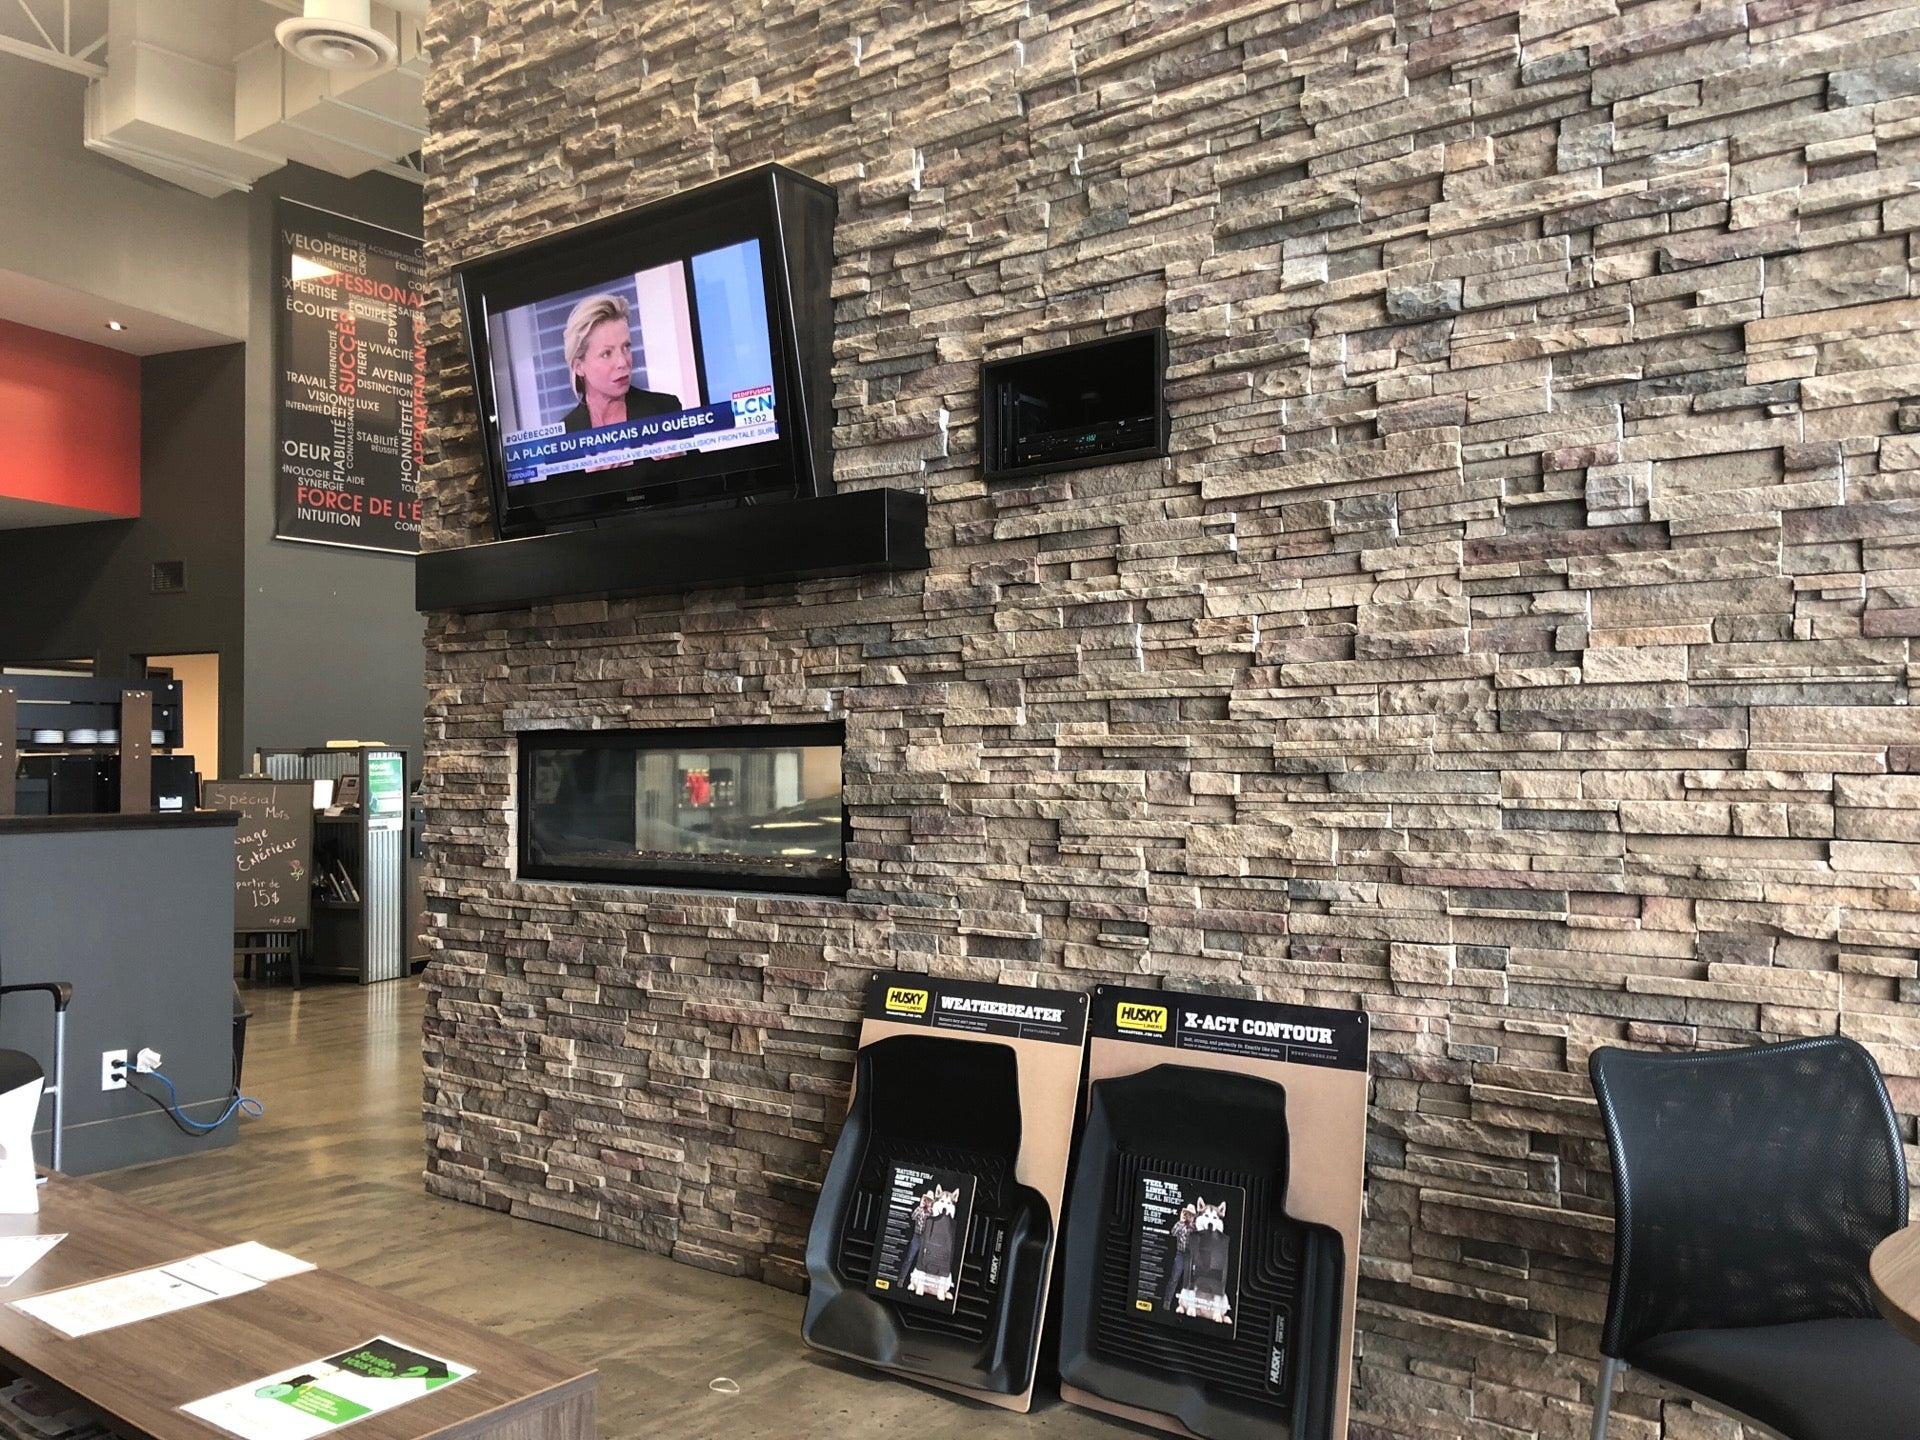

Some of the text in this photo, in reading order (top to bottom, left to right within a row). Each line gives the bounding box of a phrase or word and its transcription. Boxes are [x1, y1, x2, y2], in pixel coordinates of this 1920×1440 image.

[282, 230, 357, 263] VELOPPER
[282, 275, 338, 301] XPERTISE
[286, 294, 338, 322] ÉCOUTE
[388, 303, 398, 345] IMAGE
[328, 329, 337, 392] AUTHENTICITÉ
[335, 311, 356, 395] SUCCÈS
[355, 340, 367, 376] FIERTÉ
[368, 342, 414, 361] VIVACITÉ
[286, 370, 328, 389] TRAVAIL
[372, 366, 413, 385] AVENIR
[307, 389, 347, 406] VISION
[357, 379, 413, 398] DISTINCTION
[732, 386, 771, 399] REDIFFUSION
[285, 399, 322, 414] INTENSITÉ
[323, 402, 346, 418] DÉFI
[356, 398, 380, 411] LUXE
[733, 394, 773, 416] LCN
[743, 413, 768, 425] 13:02
[346, 396, 354, 469] CONNAISSANCE
[356, 431, 399, 448] STABILITÉ
[399, 399, 413, 482] HONNÊTETÉ
[506, 426, 563, 443] #QUÉBEC2018
[506, 411, 714, 463] LA PLACE DU FRANÇAIS AU QUÉBEC
[679, 438, 717, 450] COLLISION
[717, 430, 755, 444] FRONTALE
[282, 440, 331, 462] OEUR
[330, 419, 347, 482] FIABILITÉ
[297, 476, 345, 491] SYNERGIE
[346, 475, 366, 486] AIDE
[297, 487, 363, 513] FORCE
[369, 497, 393, 517] DE
[297, 507, 361, 527] INTUITION
[214, 786, 277, 811] Spécial
[265, 806, 290, 821] Mois
[236, 838, 298, 871] Extérieur
[235, 877, 281, 890] partir de
[252, 889, 280, 908] 15$
[889, 990, 924, 1006] HUSKY
[941, 995, 1062, 1022] WEATHERBEATER
[1121, 1007, 1163, 1023] HUSKY
[1184, 1012, 1333, 1044] X-ACT CONTOUR
[1163, 1182, 1179, 1191] THE
[1145, 1192, 1163, 1202] REAL
[989, 1255, 999, 1284] HUSKY
[1270, 1346, 1281, 1384] HUSKY
